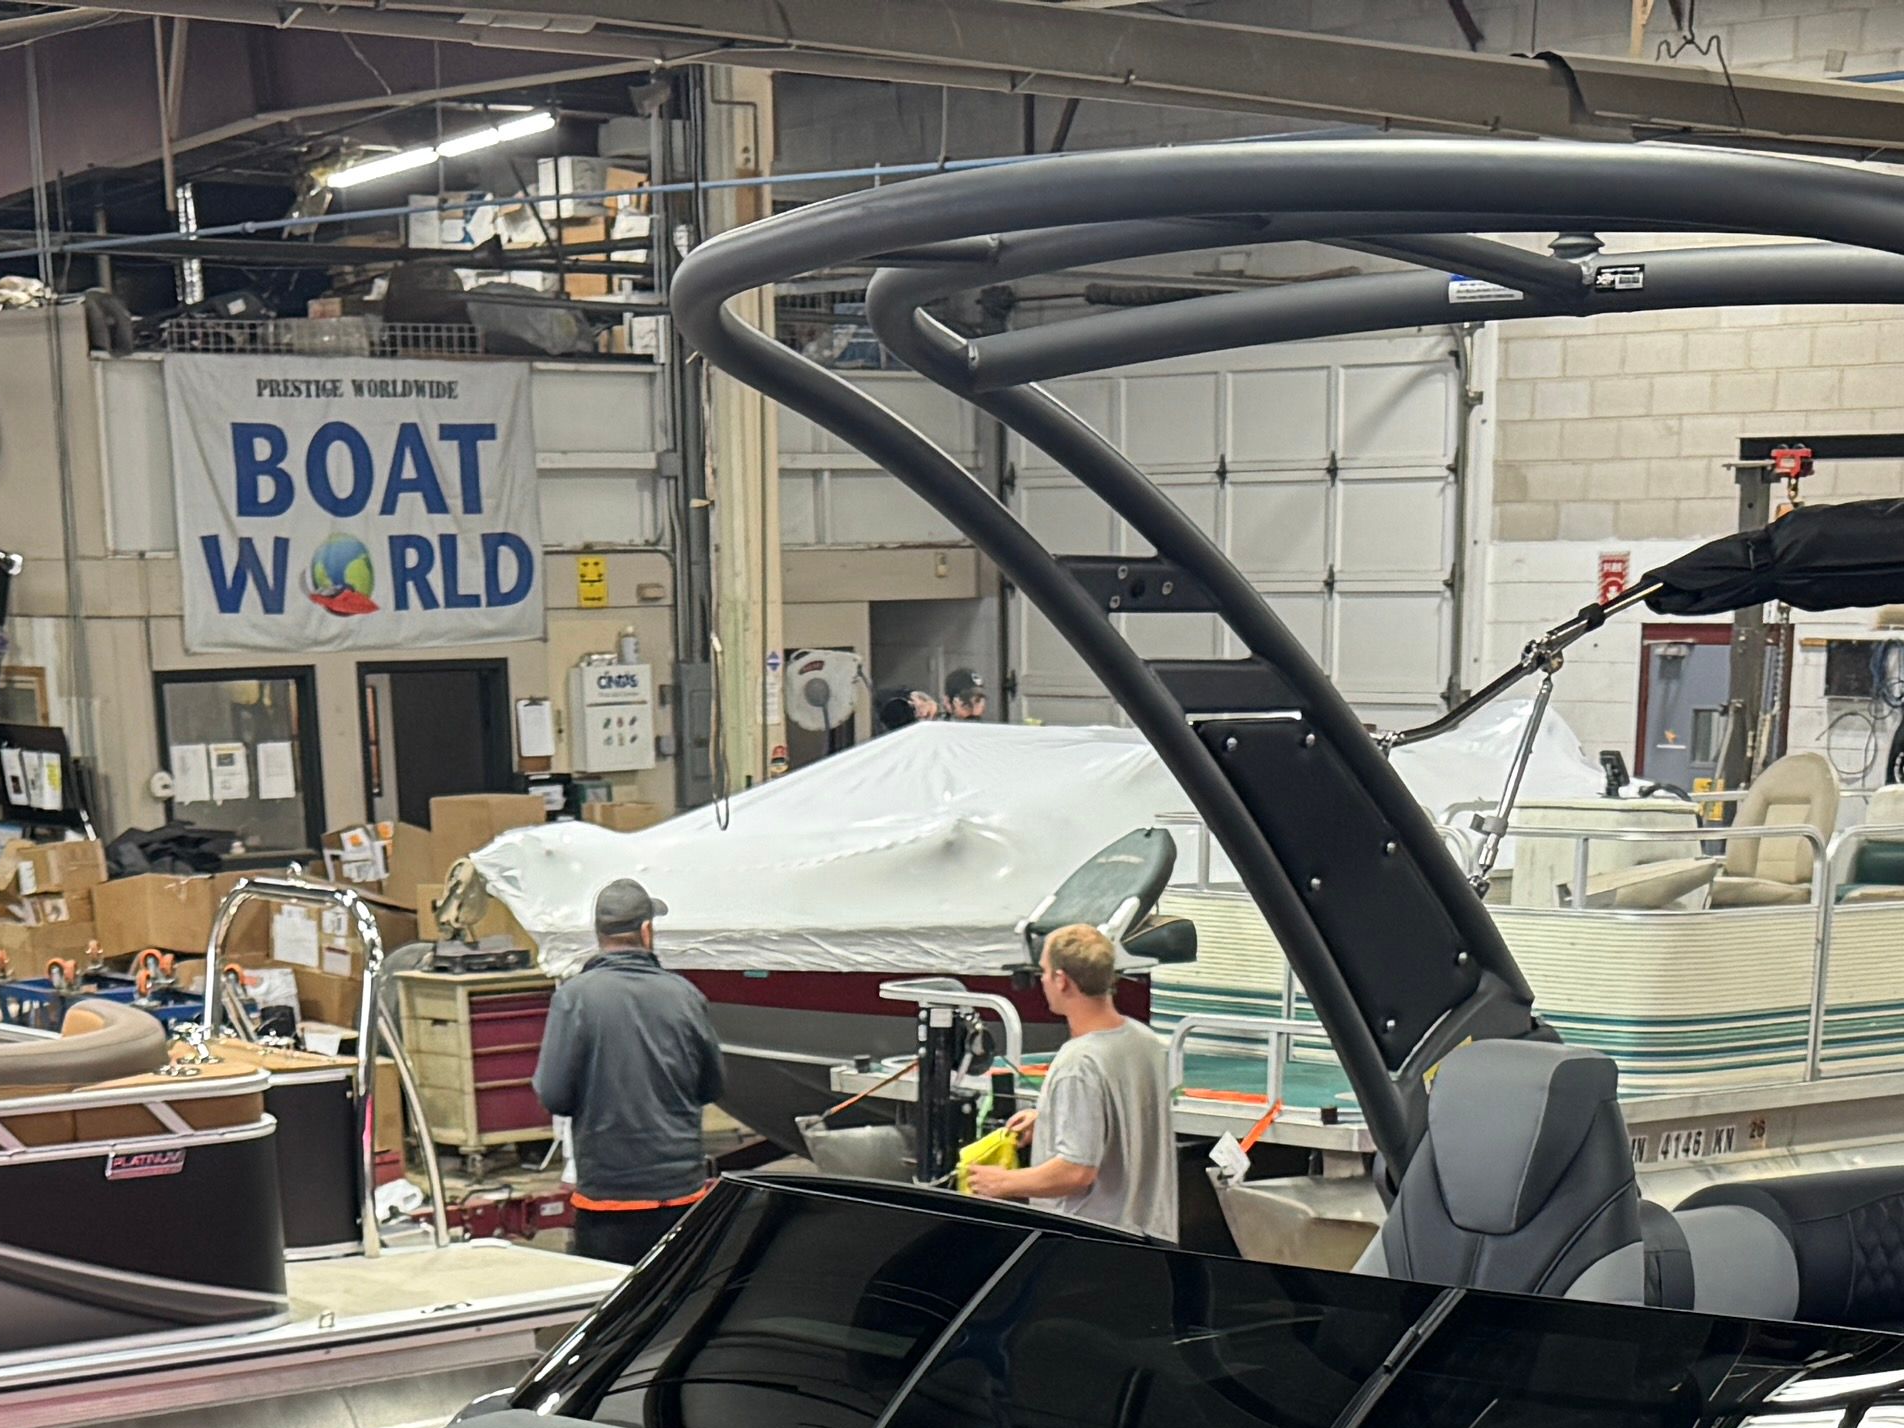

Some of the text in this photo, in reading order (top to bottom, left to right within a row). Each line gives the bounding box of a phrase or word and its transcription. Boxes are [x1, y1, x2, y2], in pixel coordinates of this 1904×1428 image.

[256, 378, 459, 399] PRESTIGE WORLDWIDE
[230, 420, 497, 518] BOAT
[1661, 1130, 1703, 1160] 4146
